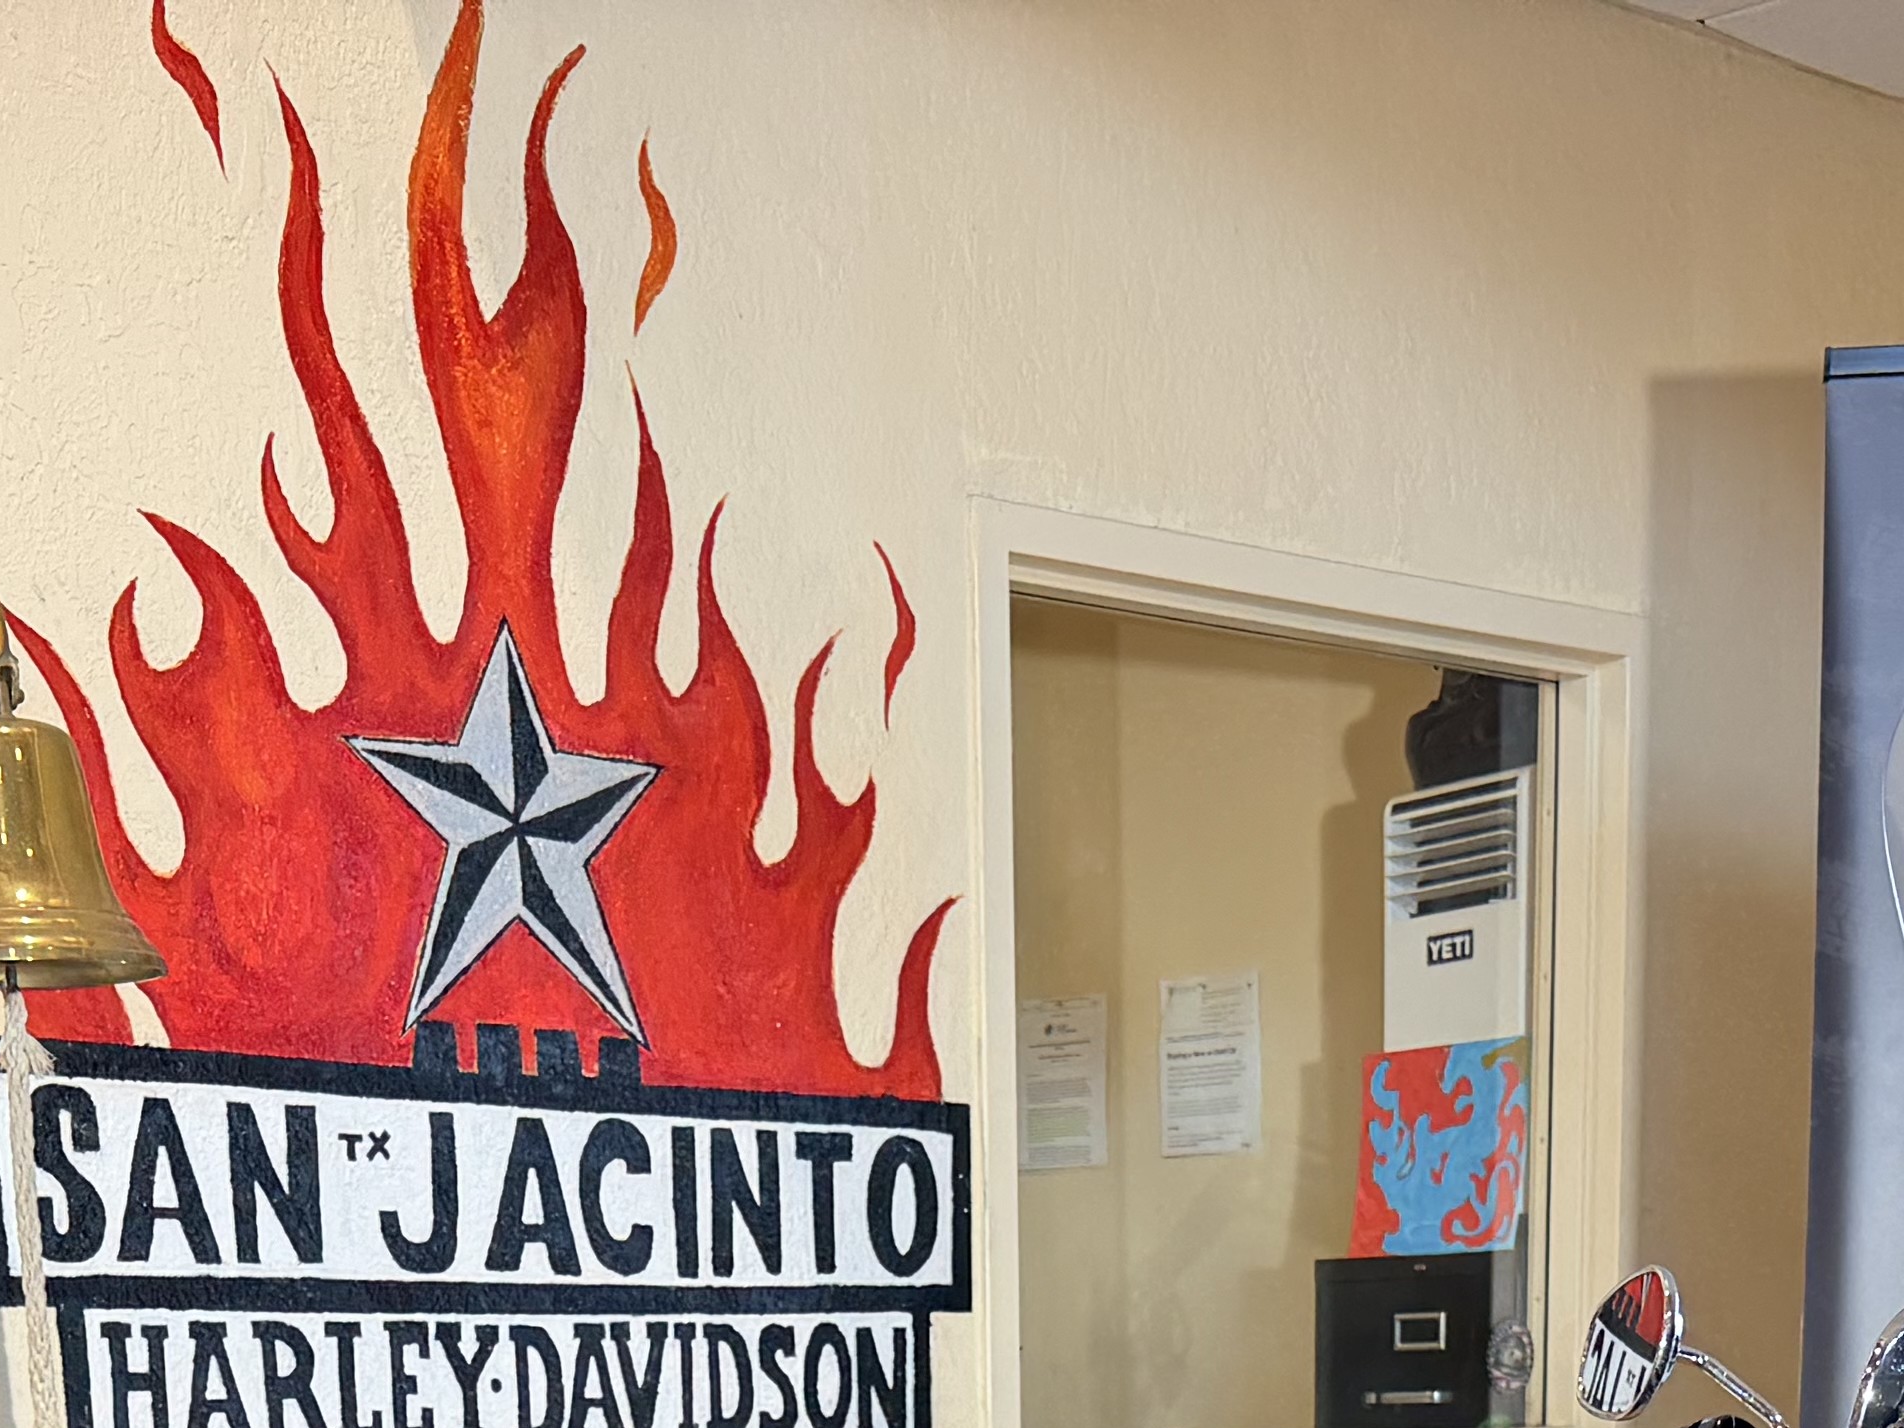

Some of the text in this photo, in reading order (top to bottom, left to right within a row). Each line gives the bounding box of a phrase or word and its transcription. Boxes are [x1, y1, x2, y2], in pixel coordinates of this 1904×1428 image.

[1429, 934, 1470, 961] YETI
[31, 1083, 939, 1278] SAN TX JACINTO
